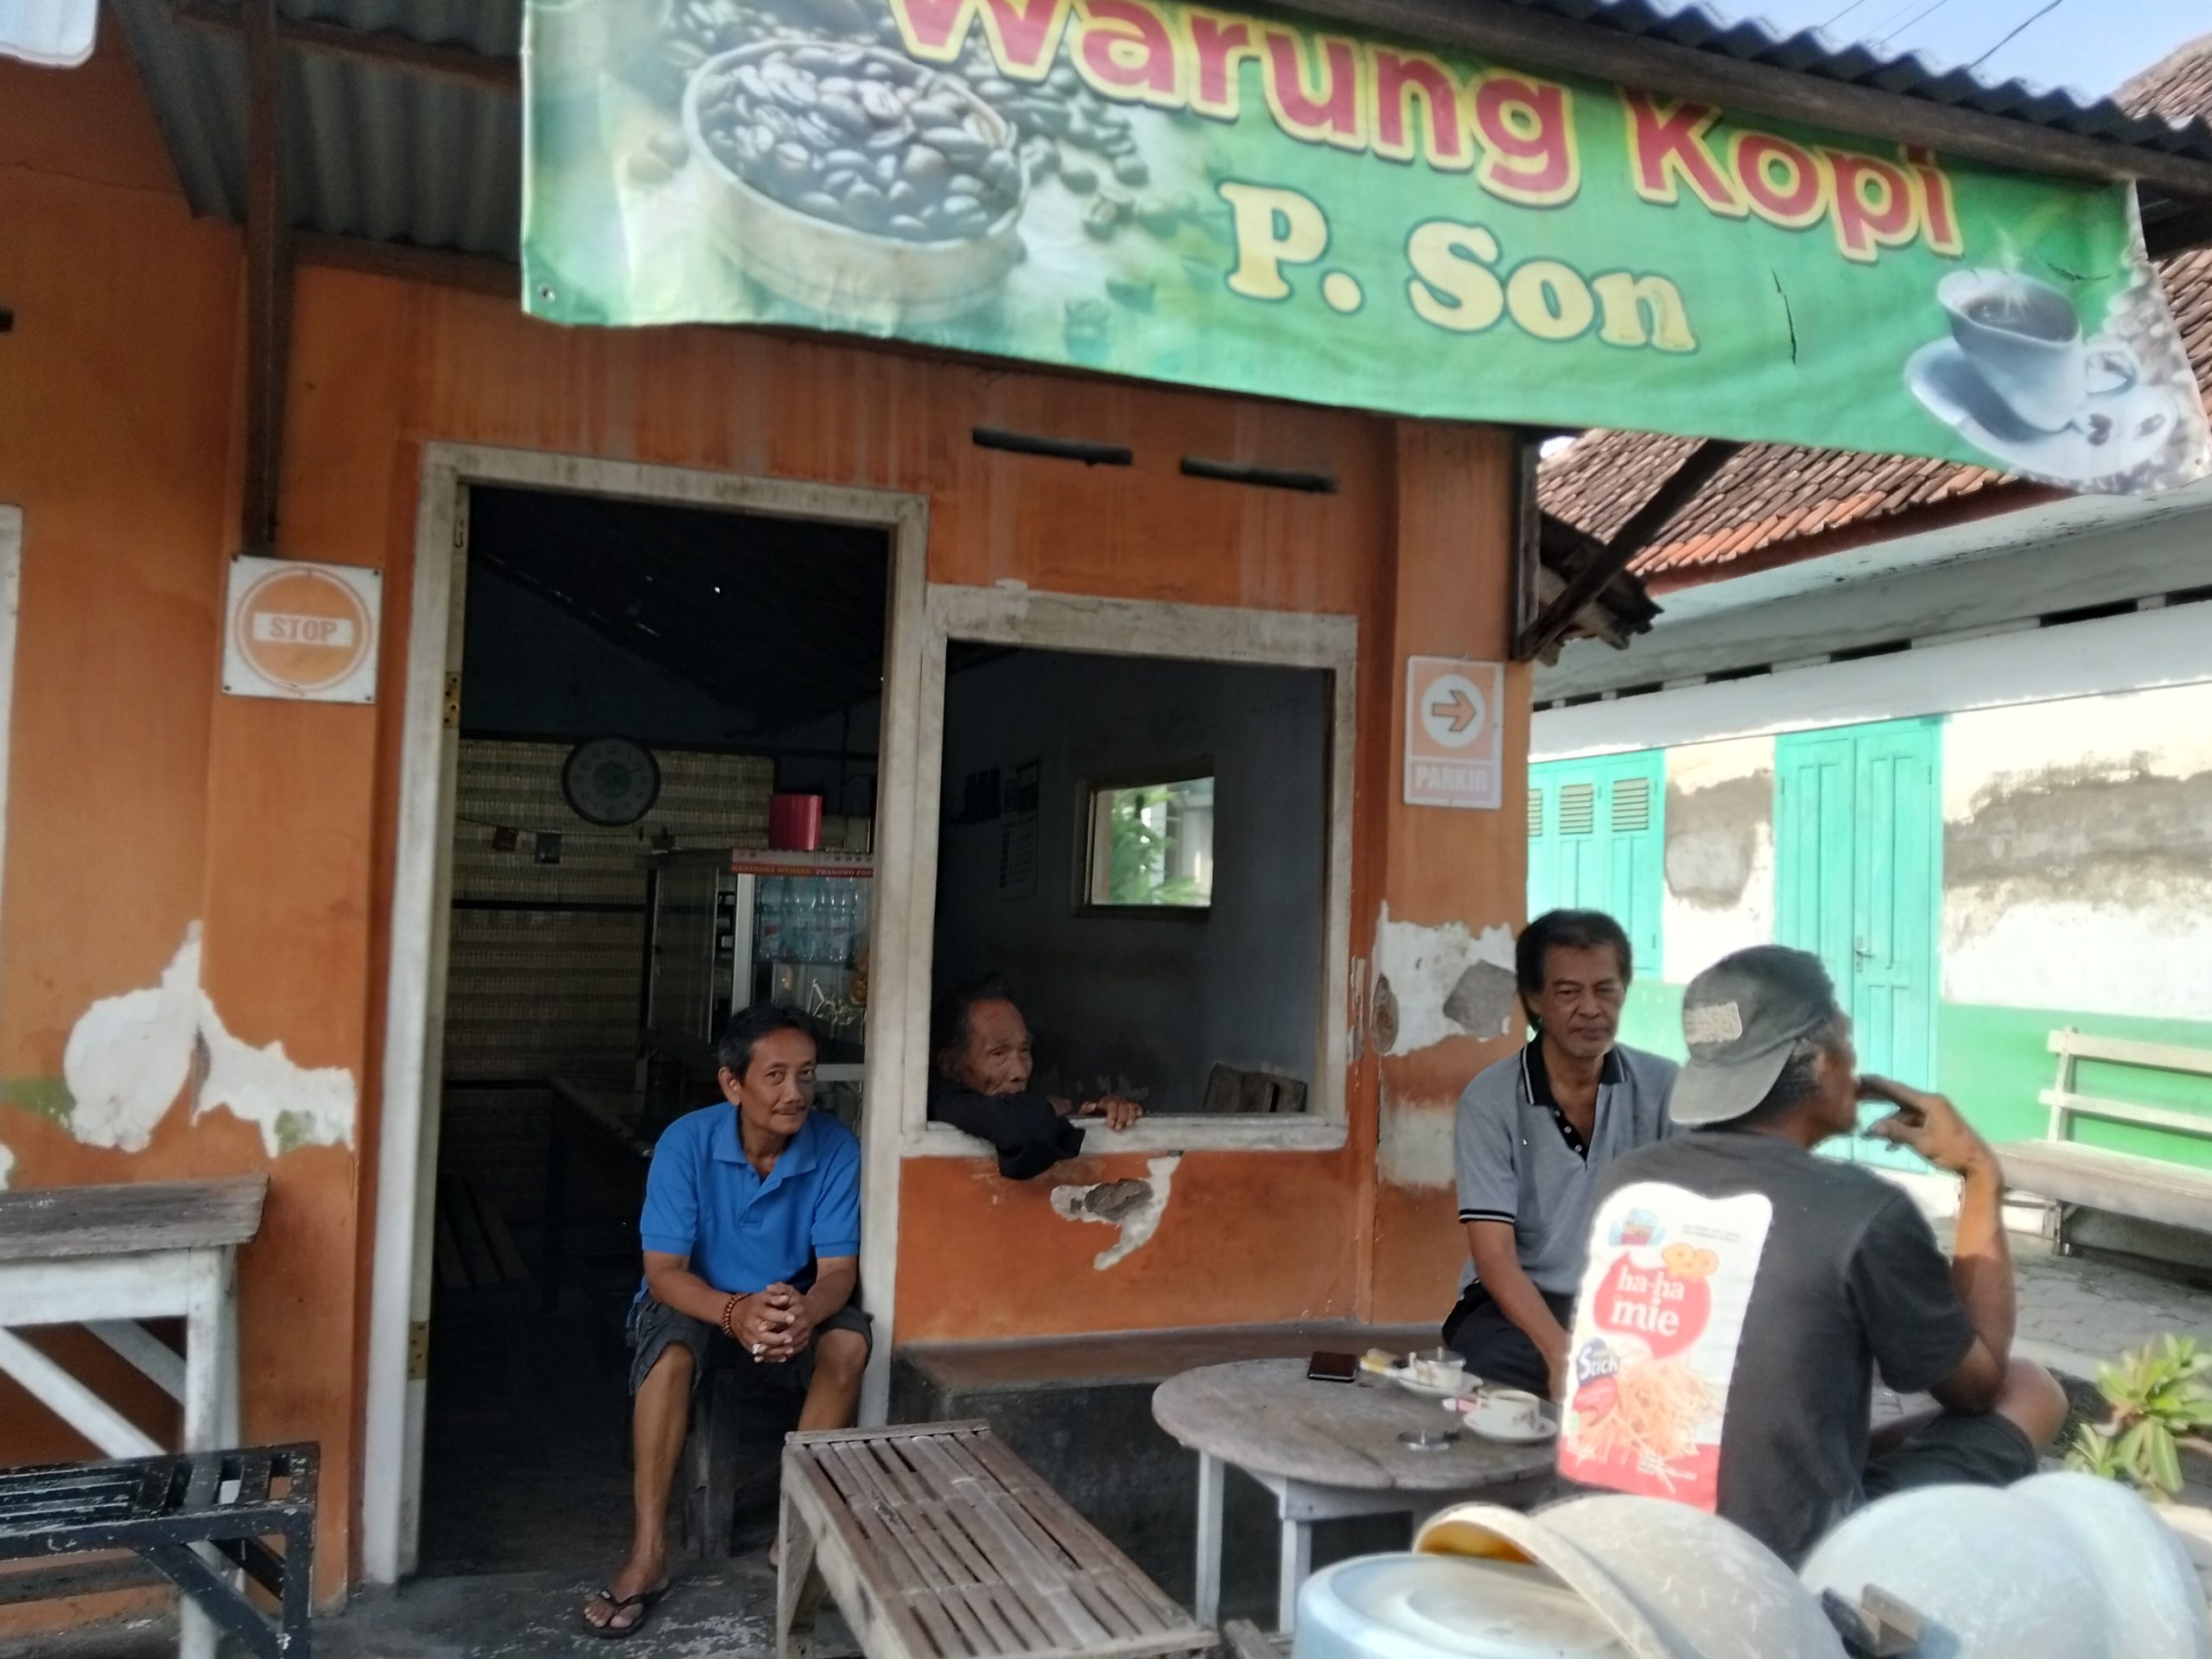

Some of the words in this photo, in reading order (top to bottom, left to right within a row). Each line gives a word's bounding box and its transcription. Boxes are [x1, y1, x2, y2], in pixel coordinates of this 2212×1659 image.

[888, 0, 1580, 205] Warung
[1619, 85, 1963, 264] Kopi
[1217, 180, 1362, 314] P.
[1407, 217, 1699, 353] Son
[269, 616, 338, 641] STOP
[1414, 764, 1489, 792] PARKIR
[1611, 1297, 1681, 1337] mie
